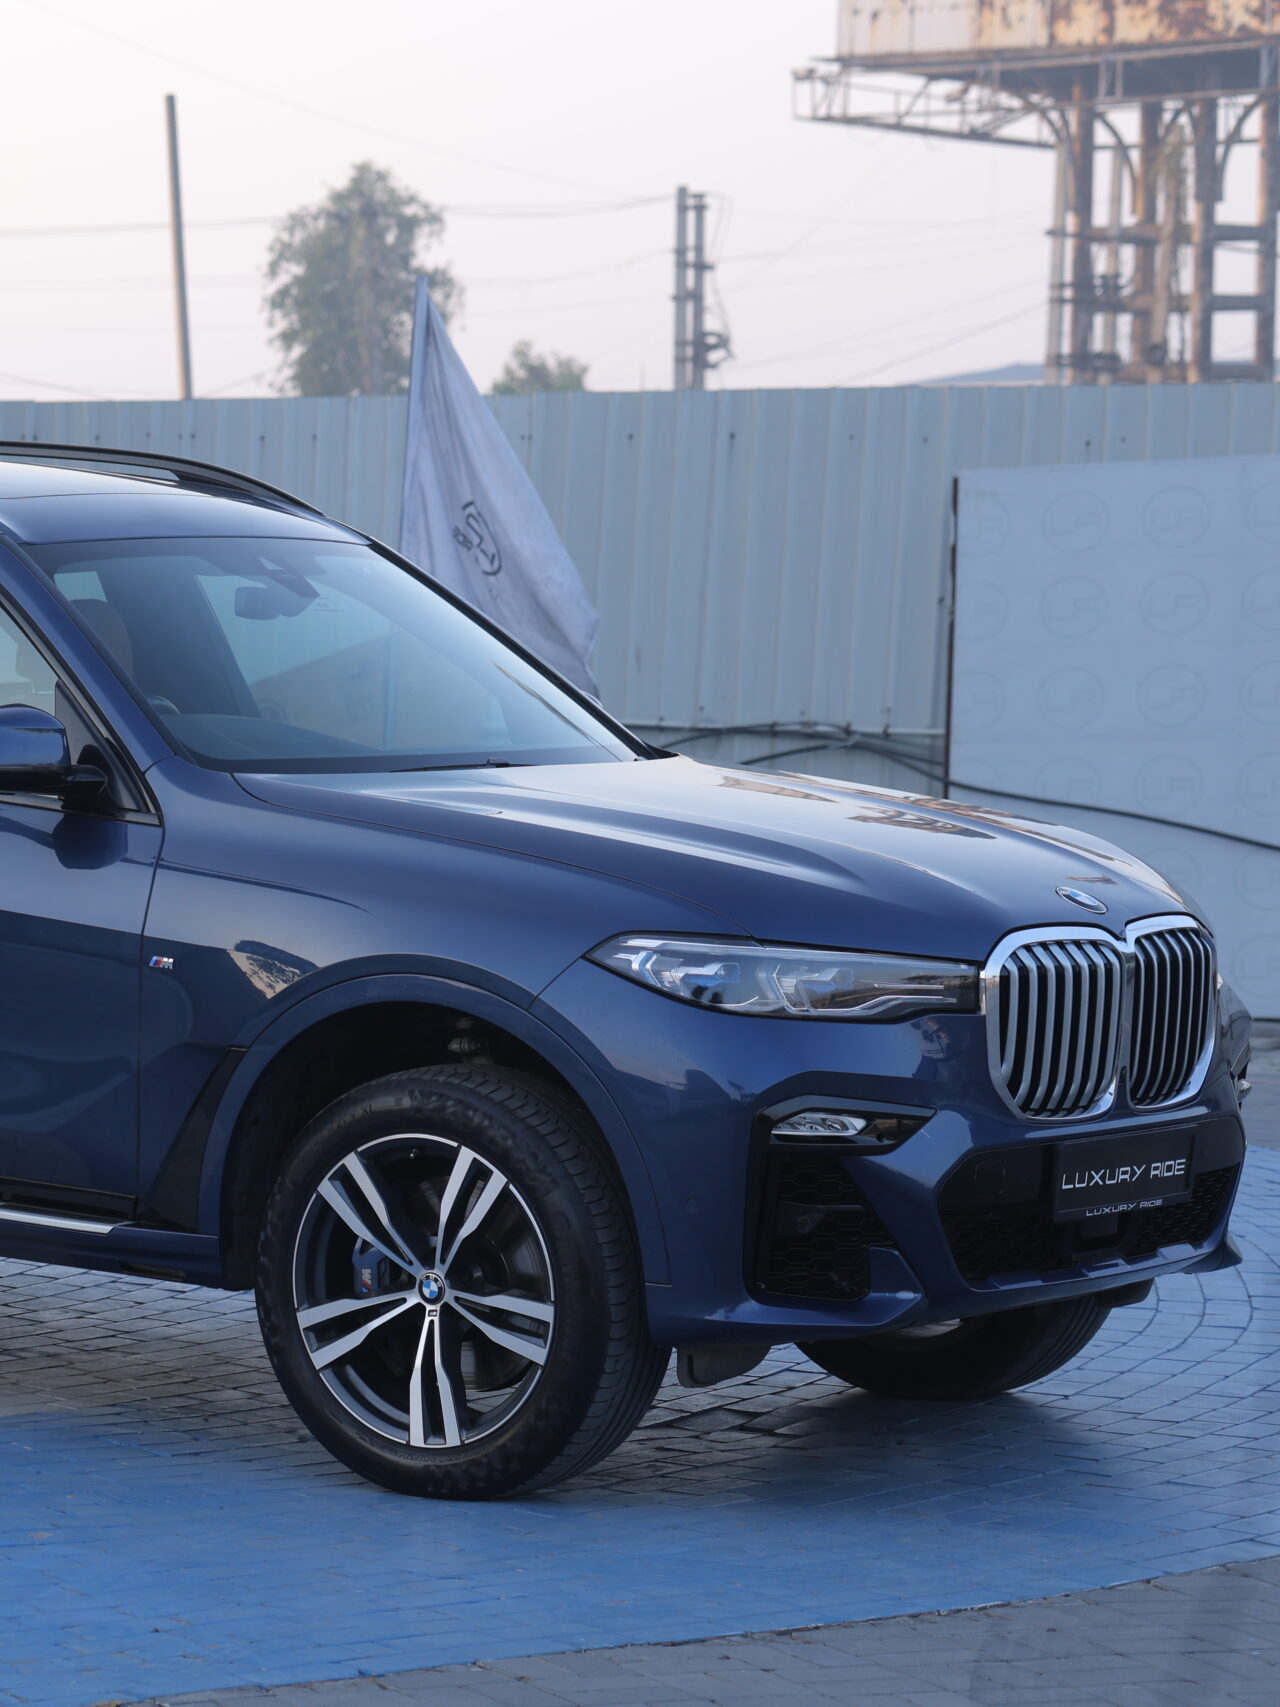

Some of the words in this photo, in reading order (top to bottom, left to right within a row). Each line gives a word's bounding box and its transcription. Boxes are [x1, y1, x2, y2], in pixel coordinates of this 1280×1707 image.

[1062, 1164, 1146, 1189] LUXURY
[1150, 1159, 1186, 1179] RIDE
[1086, 1202, 1137, 1216] LUXURY
